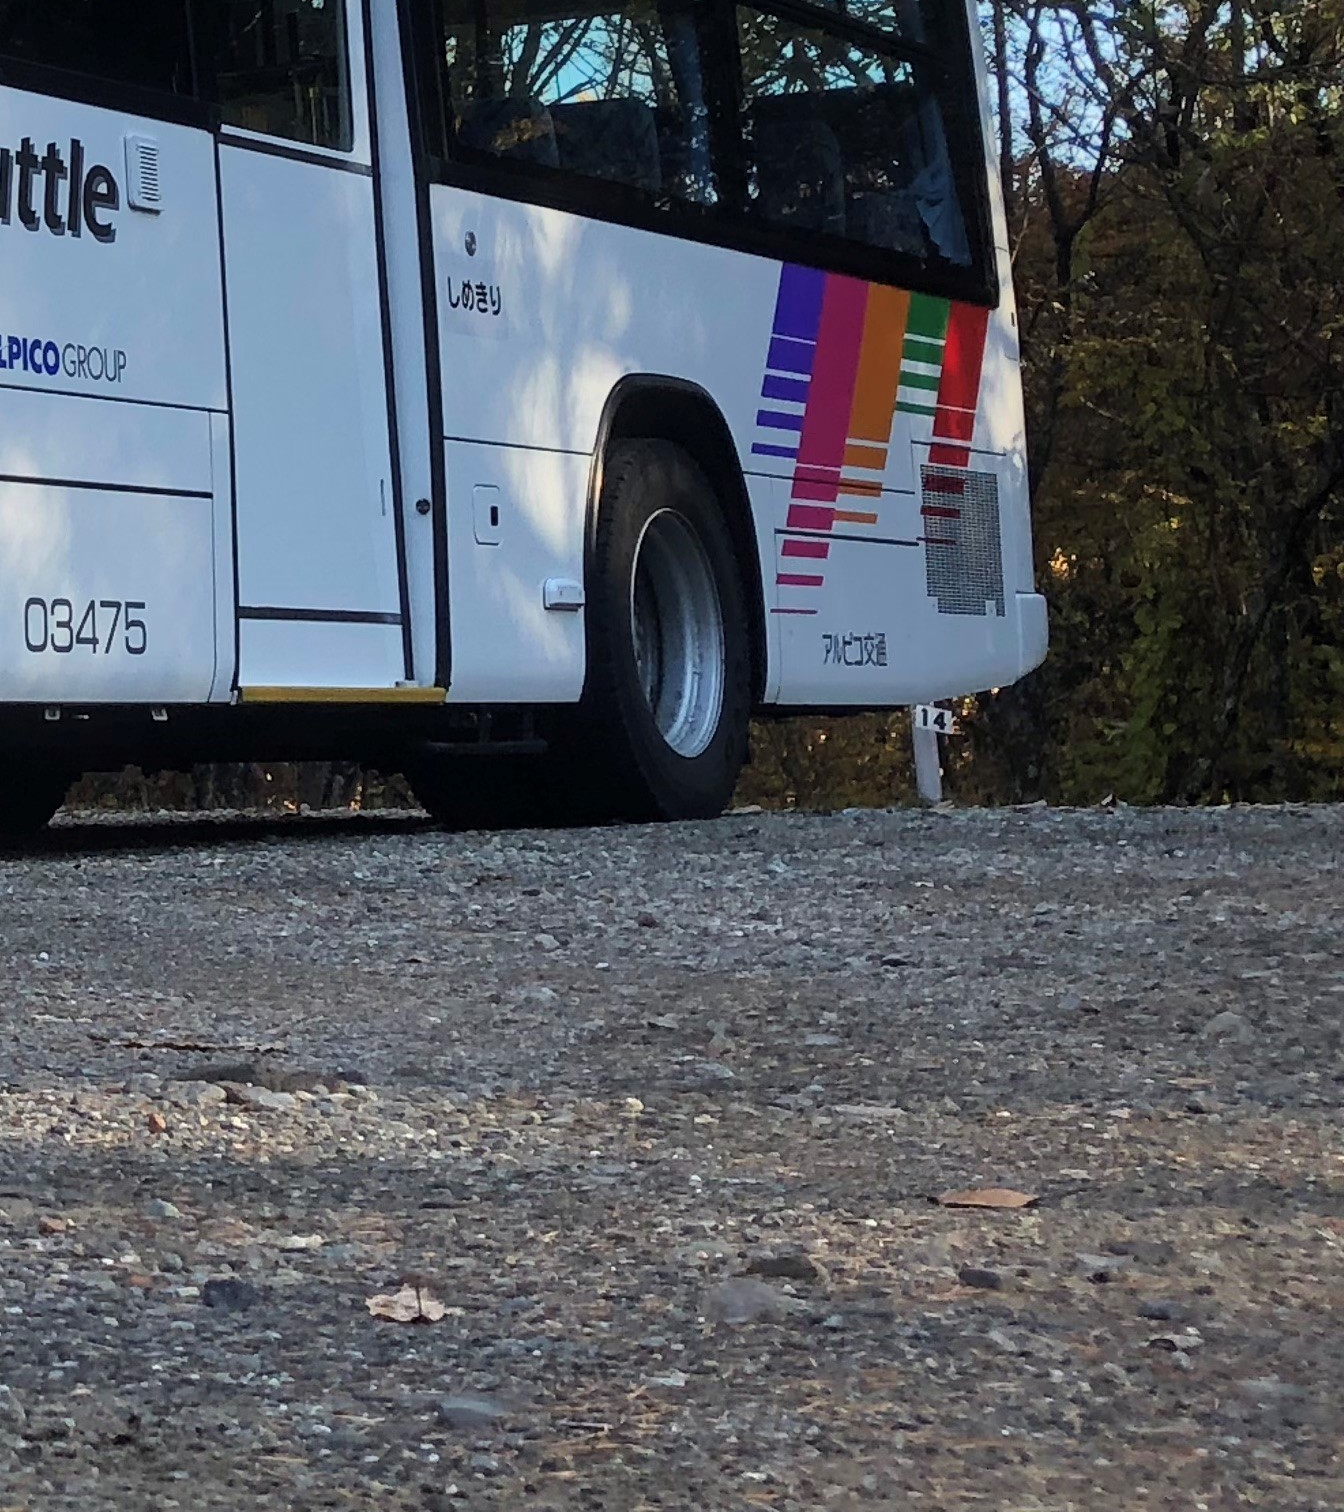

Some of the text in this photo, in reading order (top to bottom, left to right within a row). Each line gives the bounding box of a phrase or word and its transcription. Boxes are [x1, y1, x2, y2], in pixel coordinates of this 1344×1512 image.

[447, 276, 502, 316] しめきり
[24, 597, 147, 655] 03475
[921, 707, 947, 731] 14
